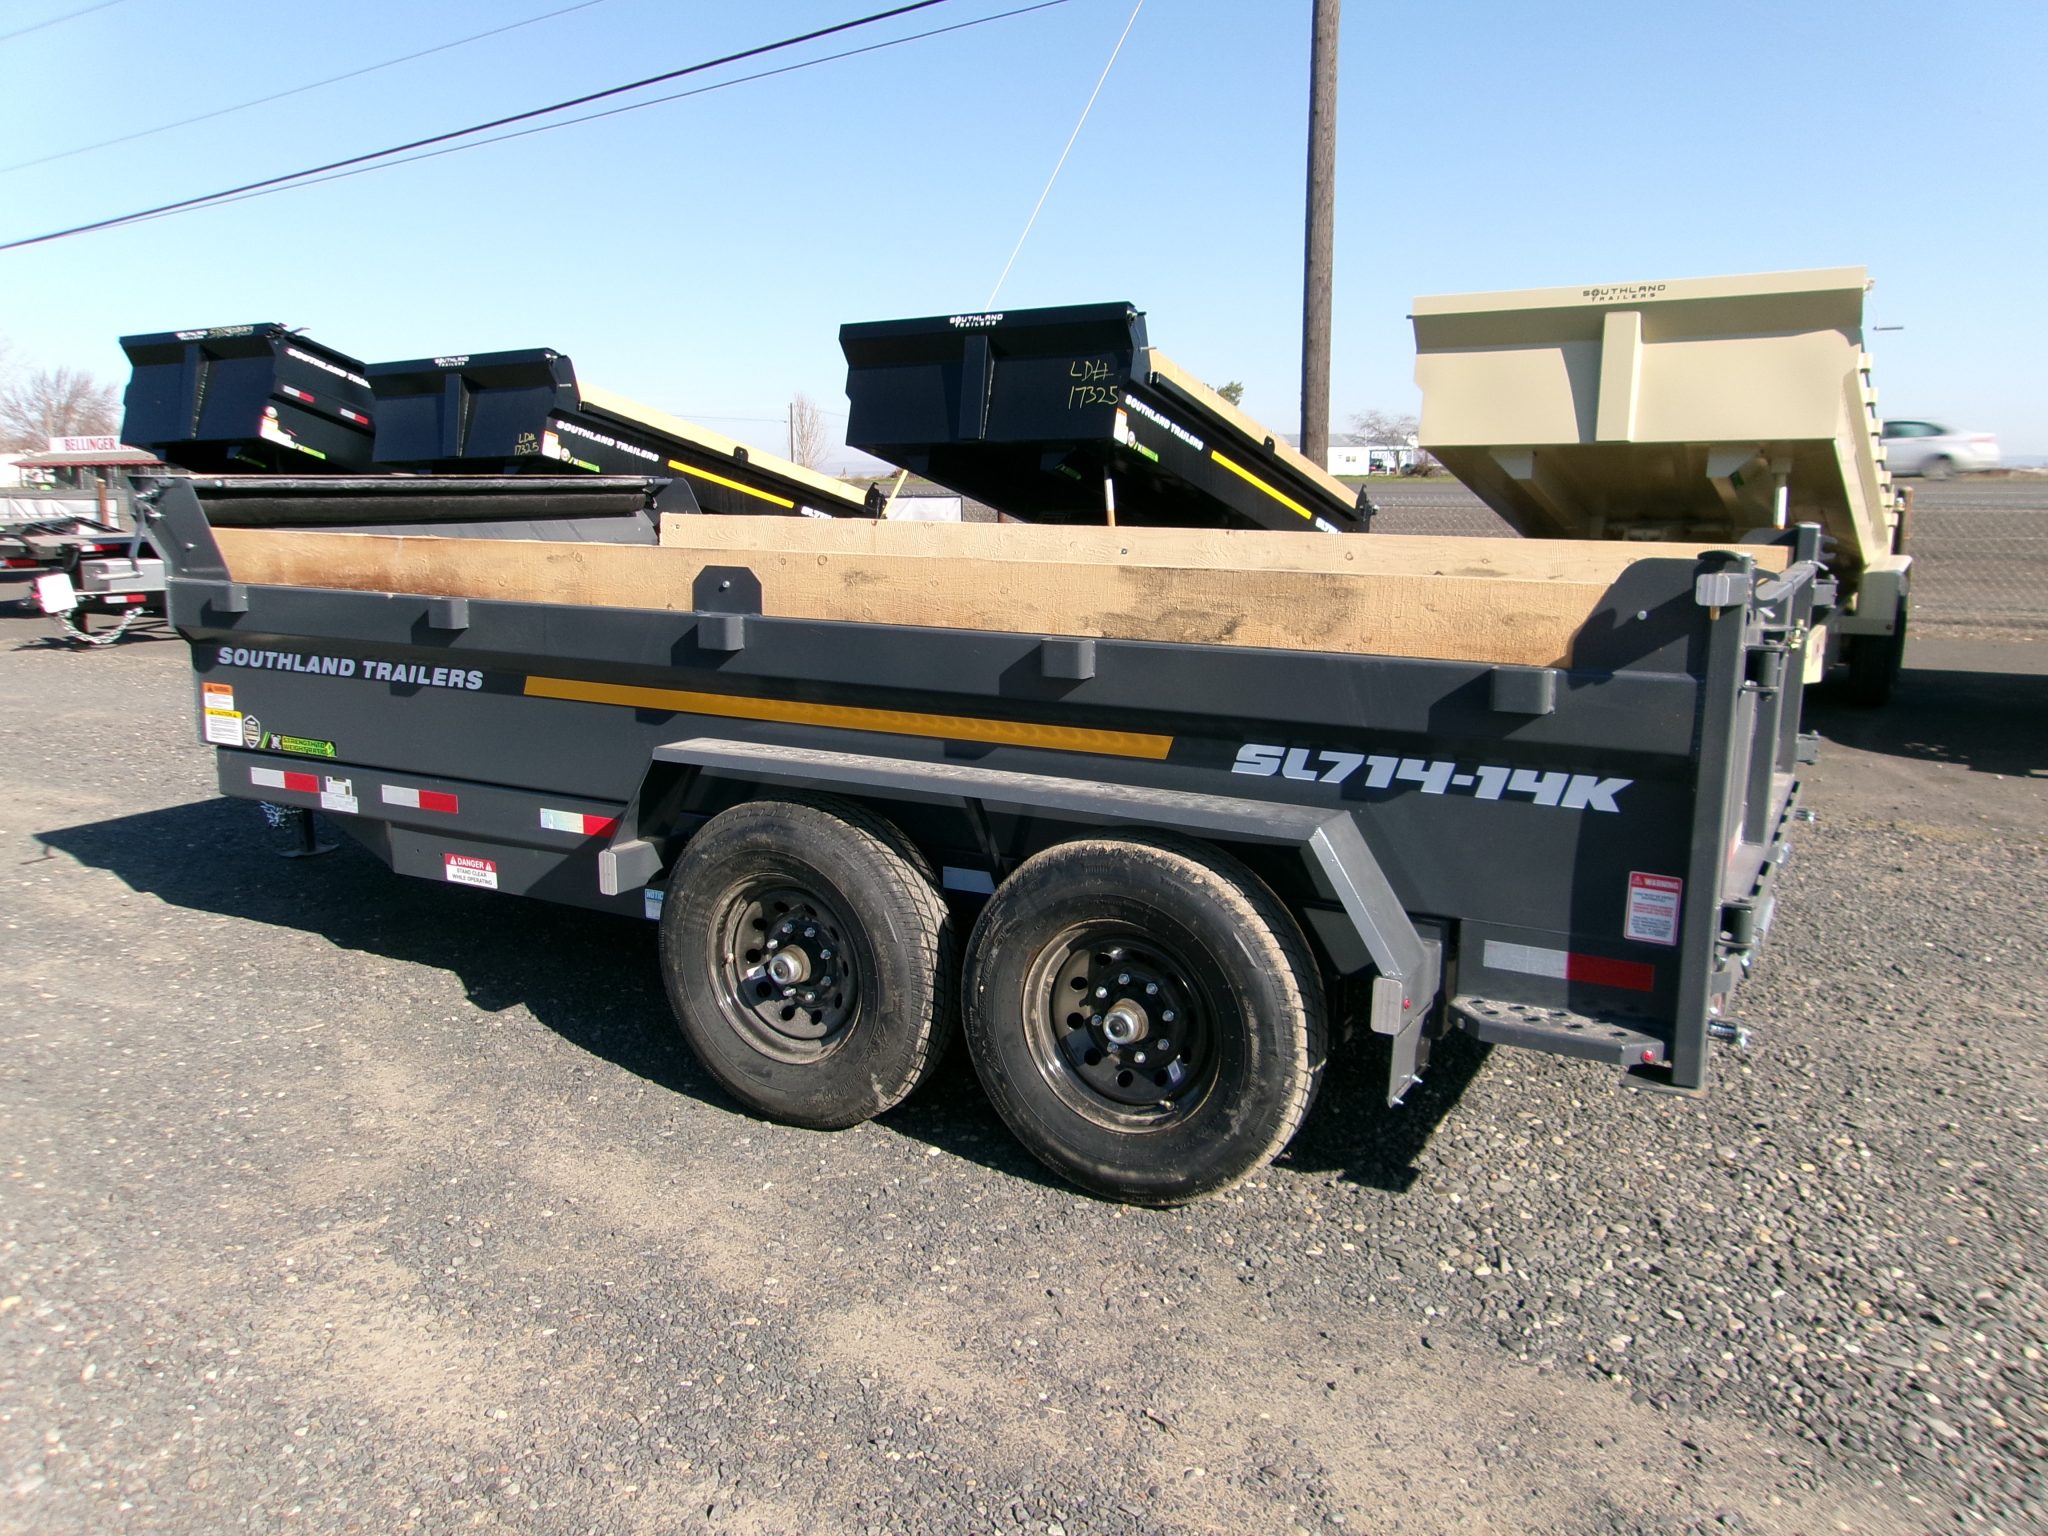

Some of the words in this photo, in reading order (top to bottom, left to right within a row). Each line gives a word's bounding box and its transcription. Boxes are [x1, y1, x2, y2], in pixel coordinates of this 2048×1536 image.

[1583, 284, 1666, 296] SOUTHLAND
[1591, 292, 1656, 301] TRAILERS
[949, 313, 1004, 324] SOUTHLAND
[1068, 385, 1119, 410] 17325
[1124, 394, 1171, 430] SOUTHLAND
[1170, 421, 1205, 451] TRAILERS
[64, 438, 117, 451] BELLINGER
[555, 420, 616, 446] SOUTHLAND
[615, 440, 660, 463] TRAILERS
[218, 647, 355, 677] SOUTHLAND
[363, 660, 484, 690] TRAILERS
[1231, 743, 1635, 813] SL714-14K
[457, 858, 484, 869] DANGER
[467, 876, 493, 885] OPERATING
[646, 891, 664, 900] NOTIC
